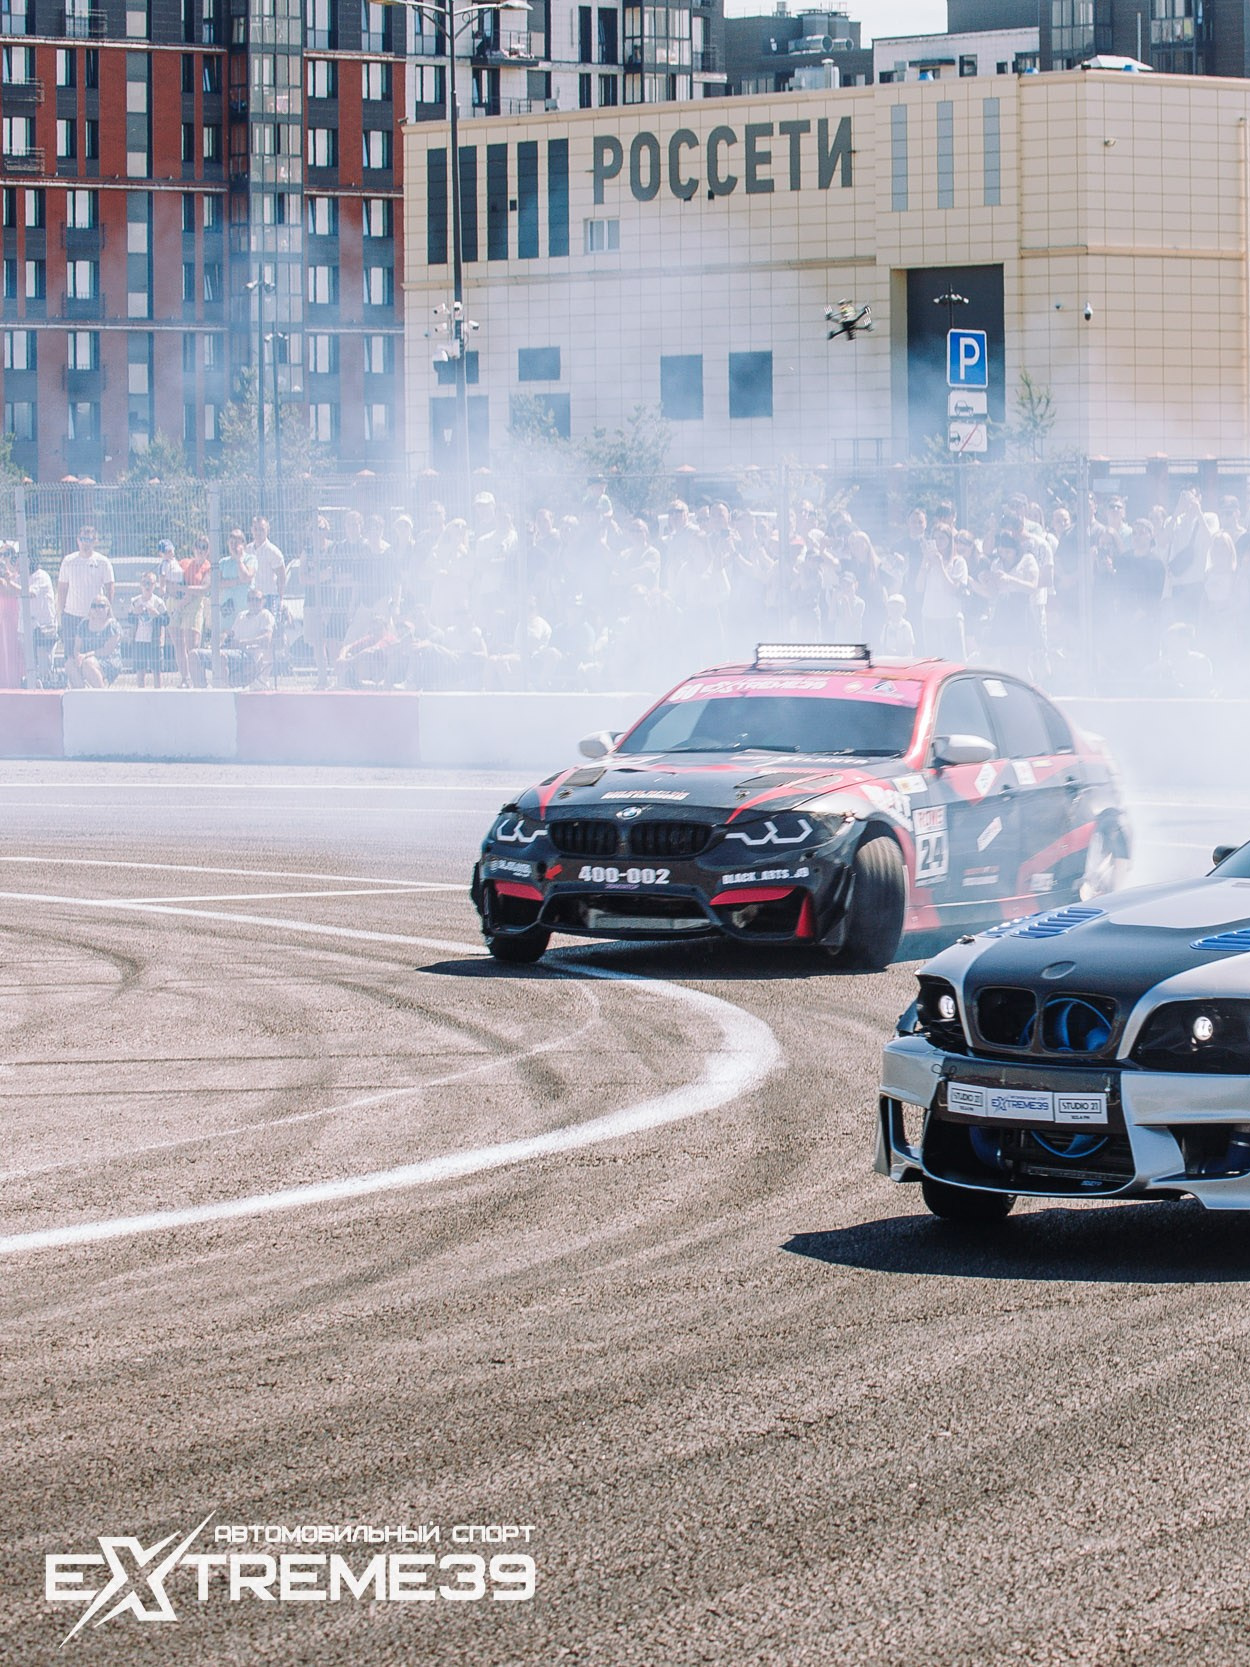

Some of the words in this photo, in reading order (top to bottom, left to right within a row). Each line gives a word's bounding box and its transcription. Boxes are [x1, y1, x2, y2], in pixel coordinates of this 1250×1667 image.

[593, 116, 853, 205] РОССЕТИ
[959, 337, 980, 380] P
[921, 837, 944, 871] 24
[578, 866, 671, 884] 400-002
[991, 1096, 1049, 1114] EXTREME39
[1062, 1102, 1089, 1110] STUDIO
